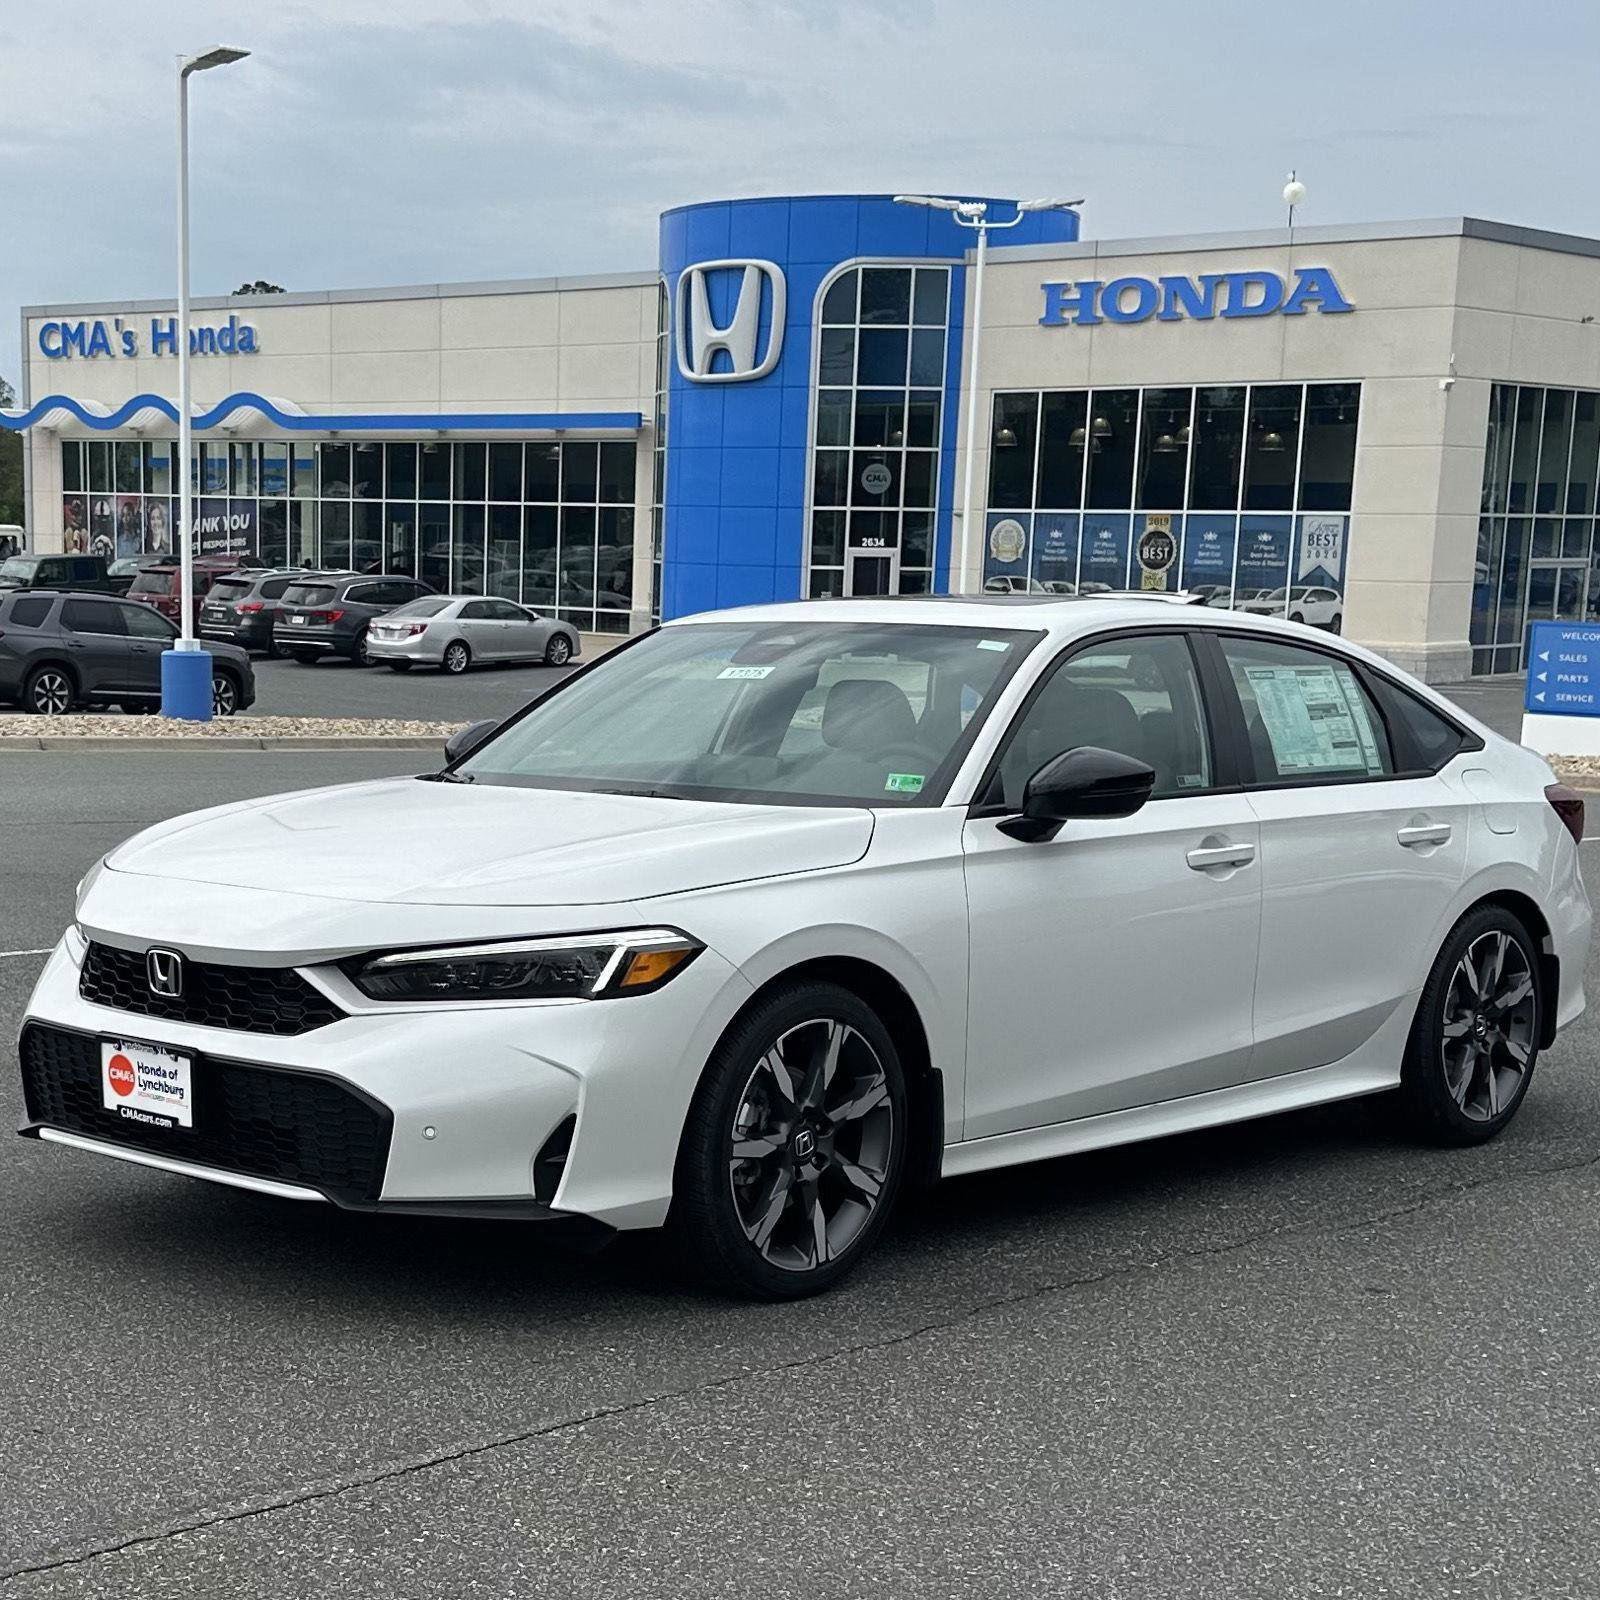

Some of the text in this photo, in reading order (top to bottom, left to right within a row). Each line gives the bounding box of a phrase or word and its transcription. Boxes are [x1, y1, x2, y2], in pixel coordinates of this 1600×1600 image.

[1039, 268, 1354, 326] HONDA
[39, 318, 137, 358] CMA's
[861, 538, 885, 547] 2634
[1307, 533, 1338, 547] BEST
[1142, 547, 1170, 560] BEST
[1559, 654, 1588, 663] SALES
[1557, 674, 1589, 683] PARTS
[1555, 693, 1594, 703] SERVICE
[137, 1060, 178, 1080] Honda of
[137, 1075, 184, 1100] Lynchburg
[120, 1107, 172, 1128] CMAcars.com
